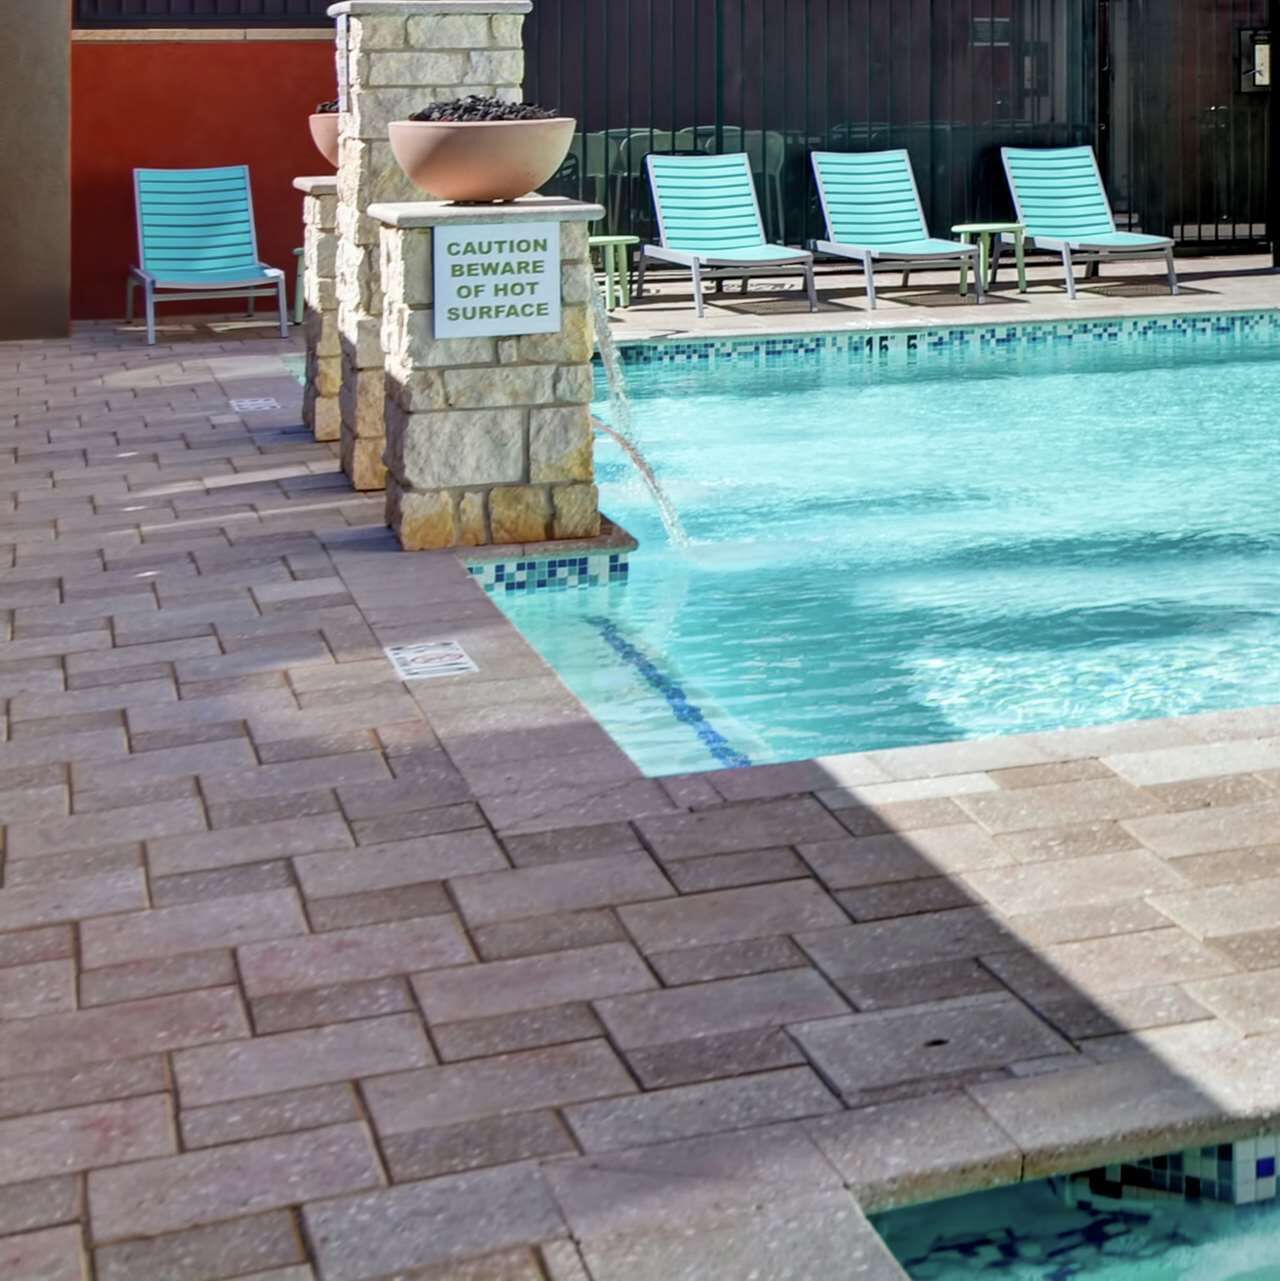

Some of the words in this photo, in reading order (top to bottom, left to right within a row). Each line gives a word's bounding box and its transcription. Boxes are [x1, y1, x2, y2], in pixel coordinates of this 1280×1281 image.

[447, 238, 548, 256] CAUTION
[450, 260, 545, 277] BEWARE
[456, 284, 485, 299] OF
[493, 282, 539, 297] HOT
[447, 302, 550, 322] SURFACE
